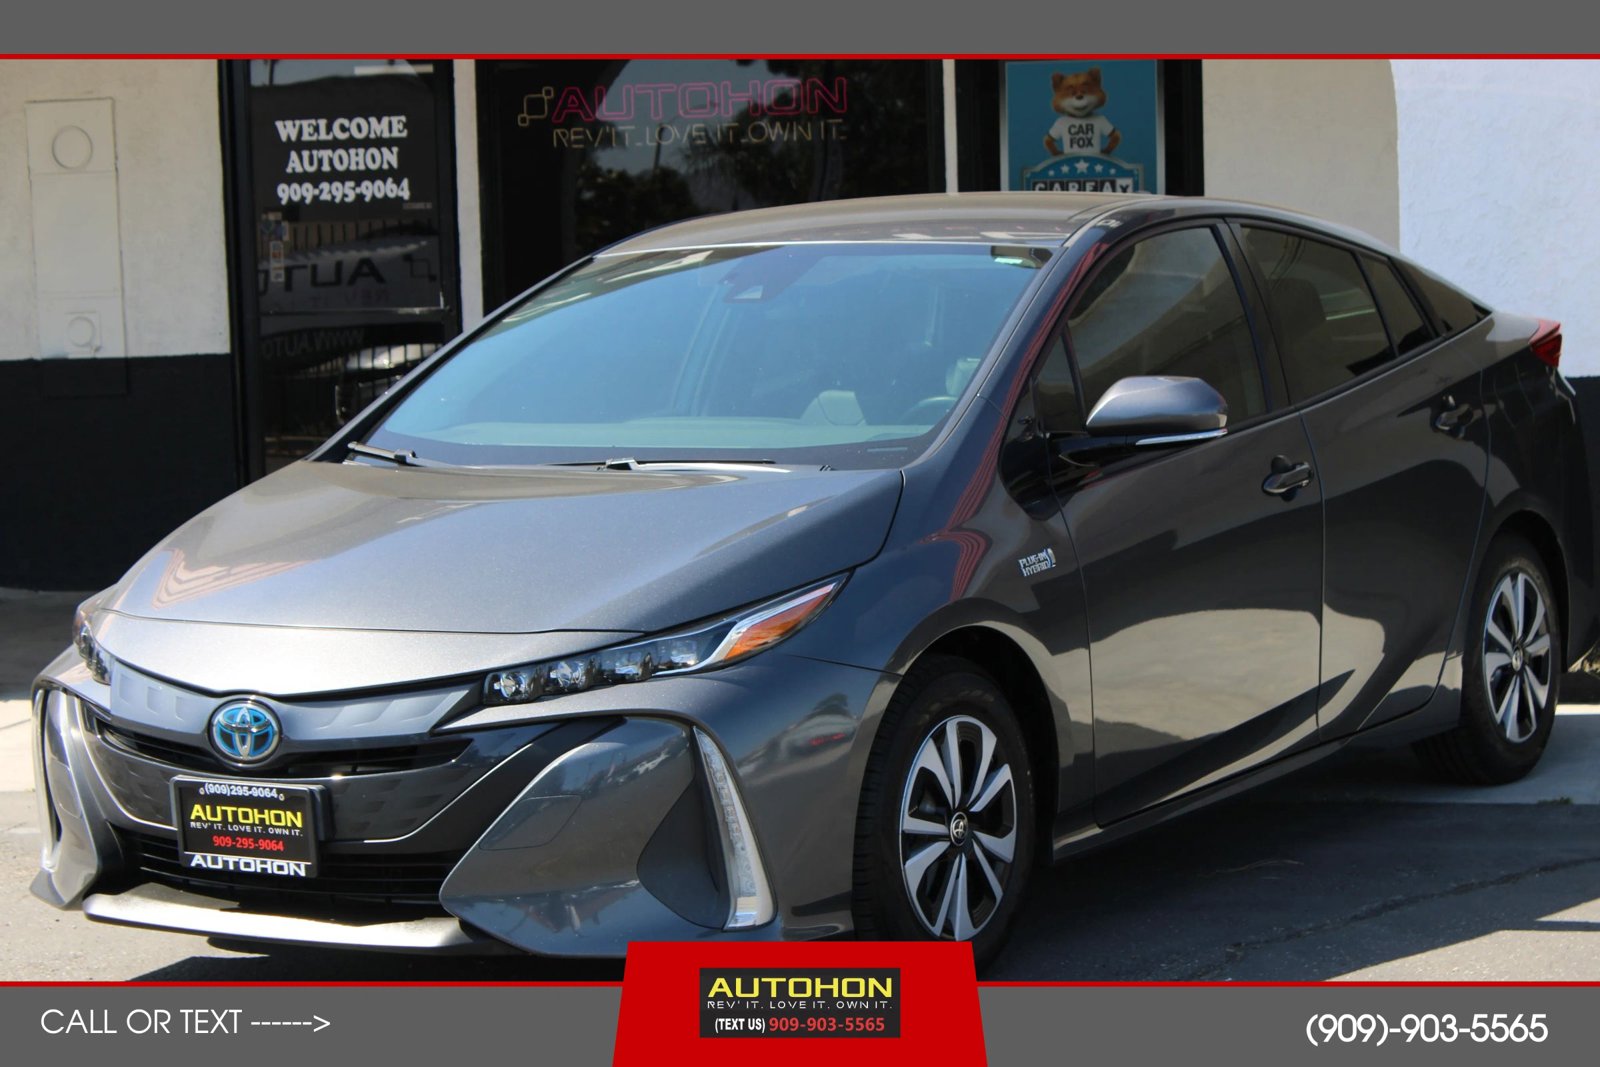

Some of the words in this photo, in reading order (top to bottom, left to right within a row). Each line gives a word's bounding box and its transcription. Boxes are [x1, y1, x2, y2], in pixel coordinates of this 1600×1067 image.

[552, 77, 848, 123] AUTOHON
[275, 115, 408, 142] WELCOME
[646, 123, 706, 145] LOVE
[748, 121, 812, 143] OWN
[1068, 123, 1095, 136] CAR
[1070, 137, 1095, 149] FOX
[286, 146, 399, 173] AUTOHON
[277, 177, 410, 206] 909-295-9064
[1018, 551, 1049, 568] PLUG-IN
[1022, 560, 1049, 577] HYBRID
[205, 783, 278, 799] (909)295-9064
[190, 804, 302, 828] AUTOHON
[228, 824, 251, 833] LOVE
[268, 827, 289, 835] OWN
[212, 835, 284, 851] 909-295-9064
[190, 854, 306, 877] AUTOHON
